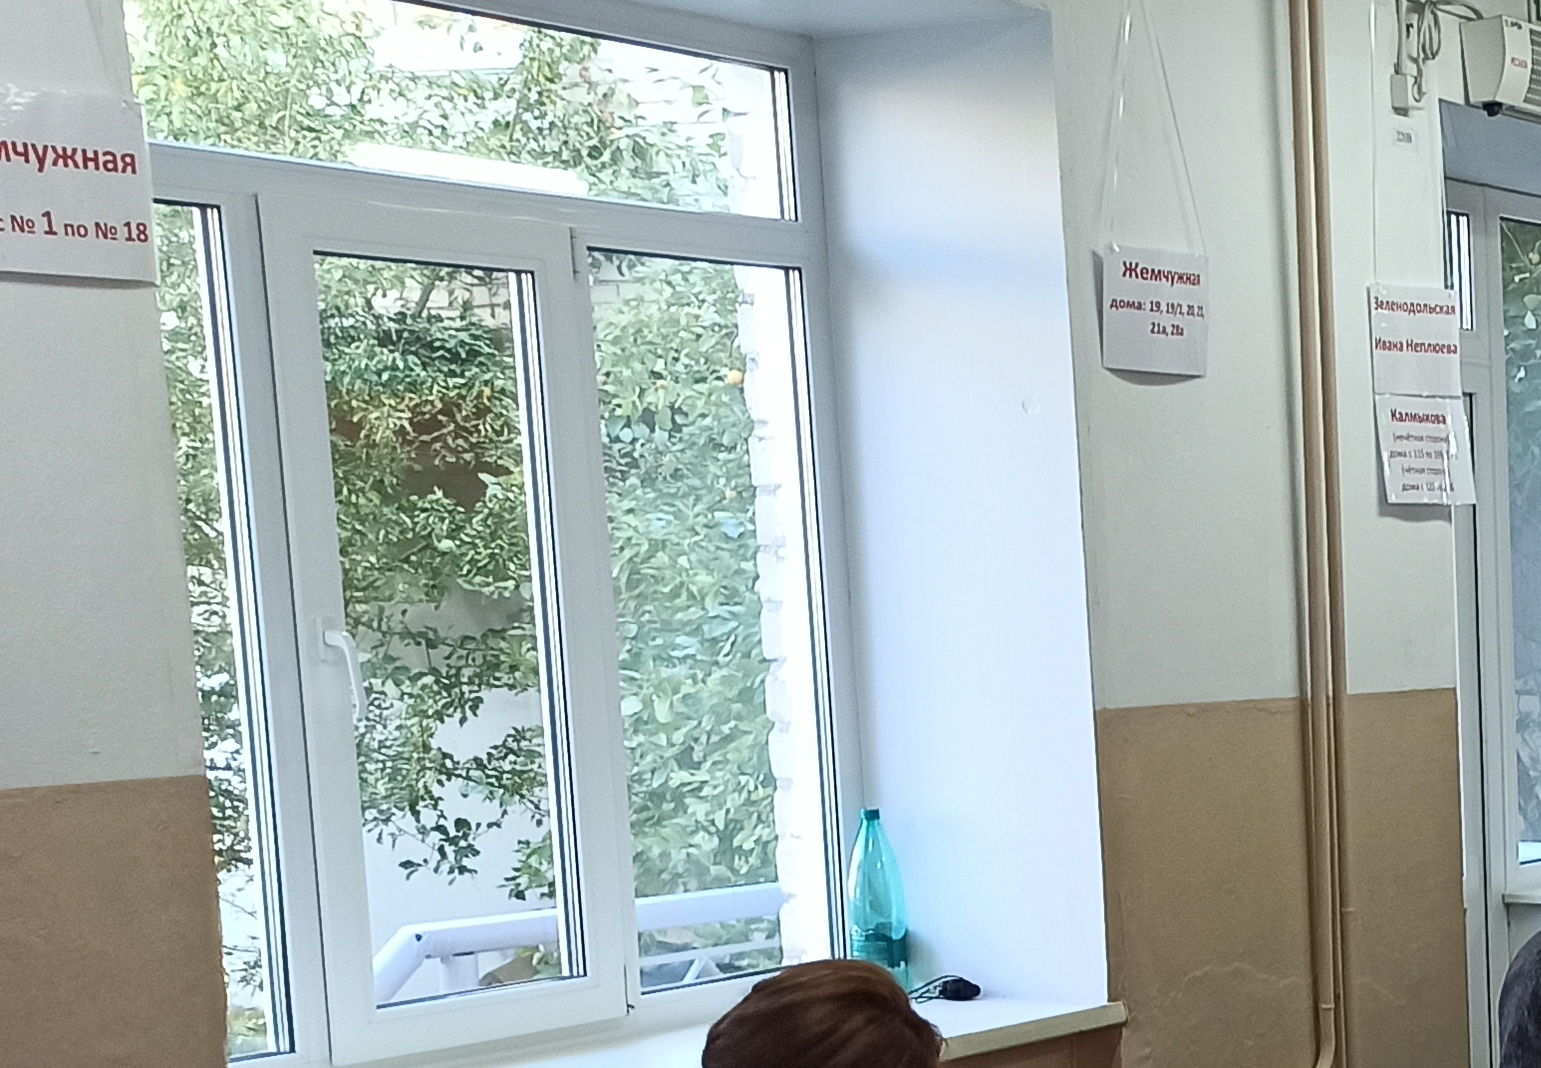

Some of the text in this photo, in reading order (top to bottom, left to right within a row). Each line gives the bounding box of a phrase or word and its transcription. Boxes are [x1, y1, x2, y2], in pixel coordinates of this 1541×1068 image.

[41, 210, 58, 236] 1
[63, 222, 89, 239] по
[123, 221, 149, 243] 18
[1121, 260, 1201, 287] Жемчужная
[1109, 298, 1146, 311] дома:
[1149, 300, 1163, 315] 19,
[1373, 296, 1456, 315] Зеленодольская
[1375, 336, 1404, 352] Ивана
